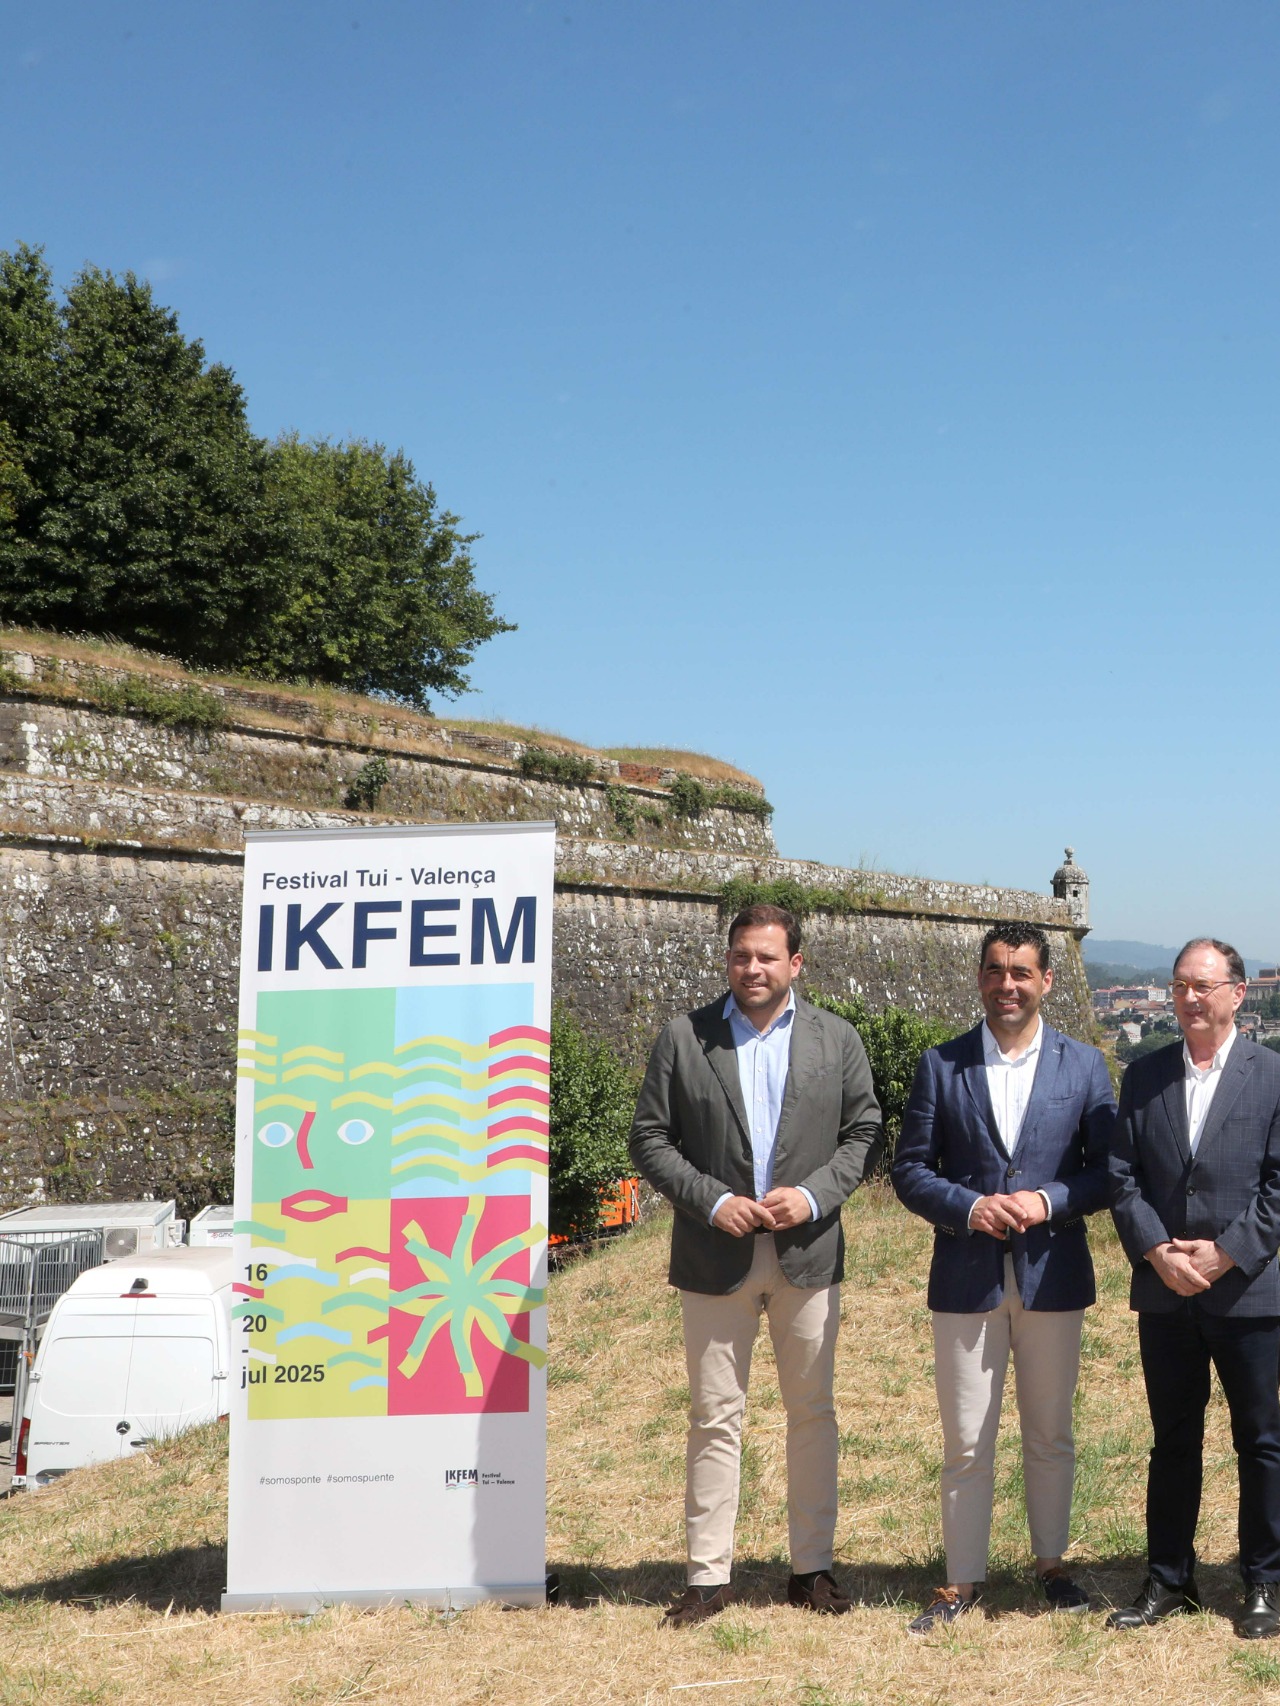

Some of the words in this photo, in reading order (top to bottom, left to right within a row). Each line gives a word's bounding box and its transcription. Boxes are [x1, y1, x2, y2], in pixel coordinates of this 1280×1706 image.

[262, 871, 348, 890] Festival
[356, 869, 388, 887] Tui
[410, 867, 496, 889] Valença
[257, 896, 537, 972] IKFEM
[244, 1263, 268, 1282] 16
[242, 1314, 267, 1333] 20
[240, 1365, 267, 1389] jul
[274, 1364, 325, 1383] 2025
[259, 1475, 321, 1486] #somosponte
[327, 1473, 395, 1484] #somospuente
[445, 1469, 478, 1483] IKFEM
